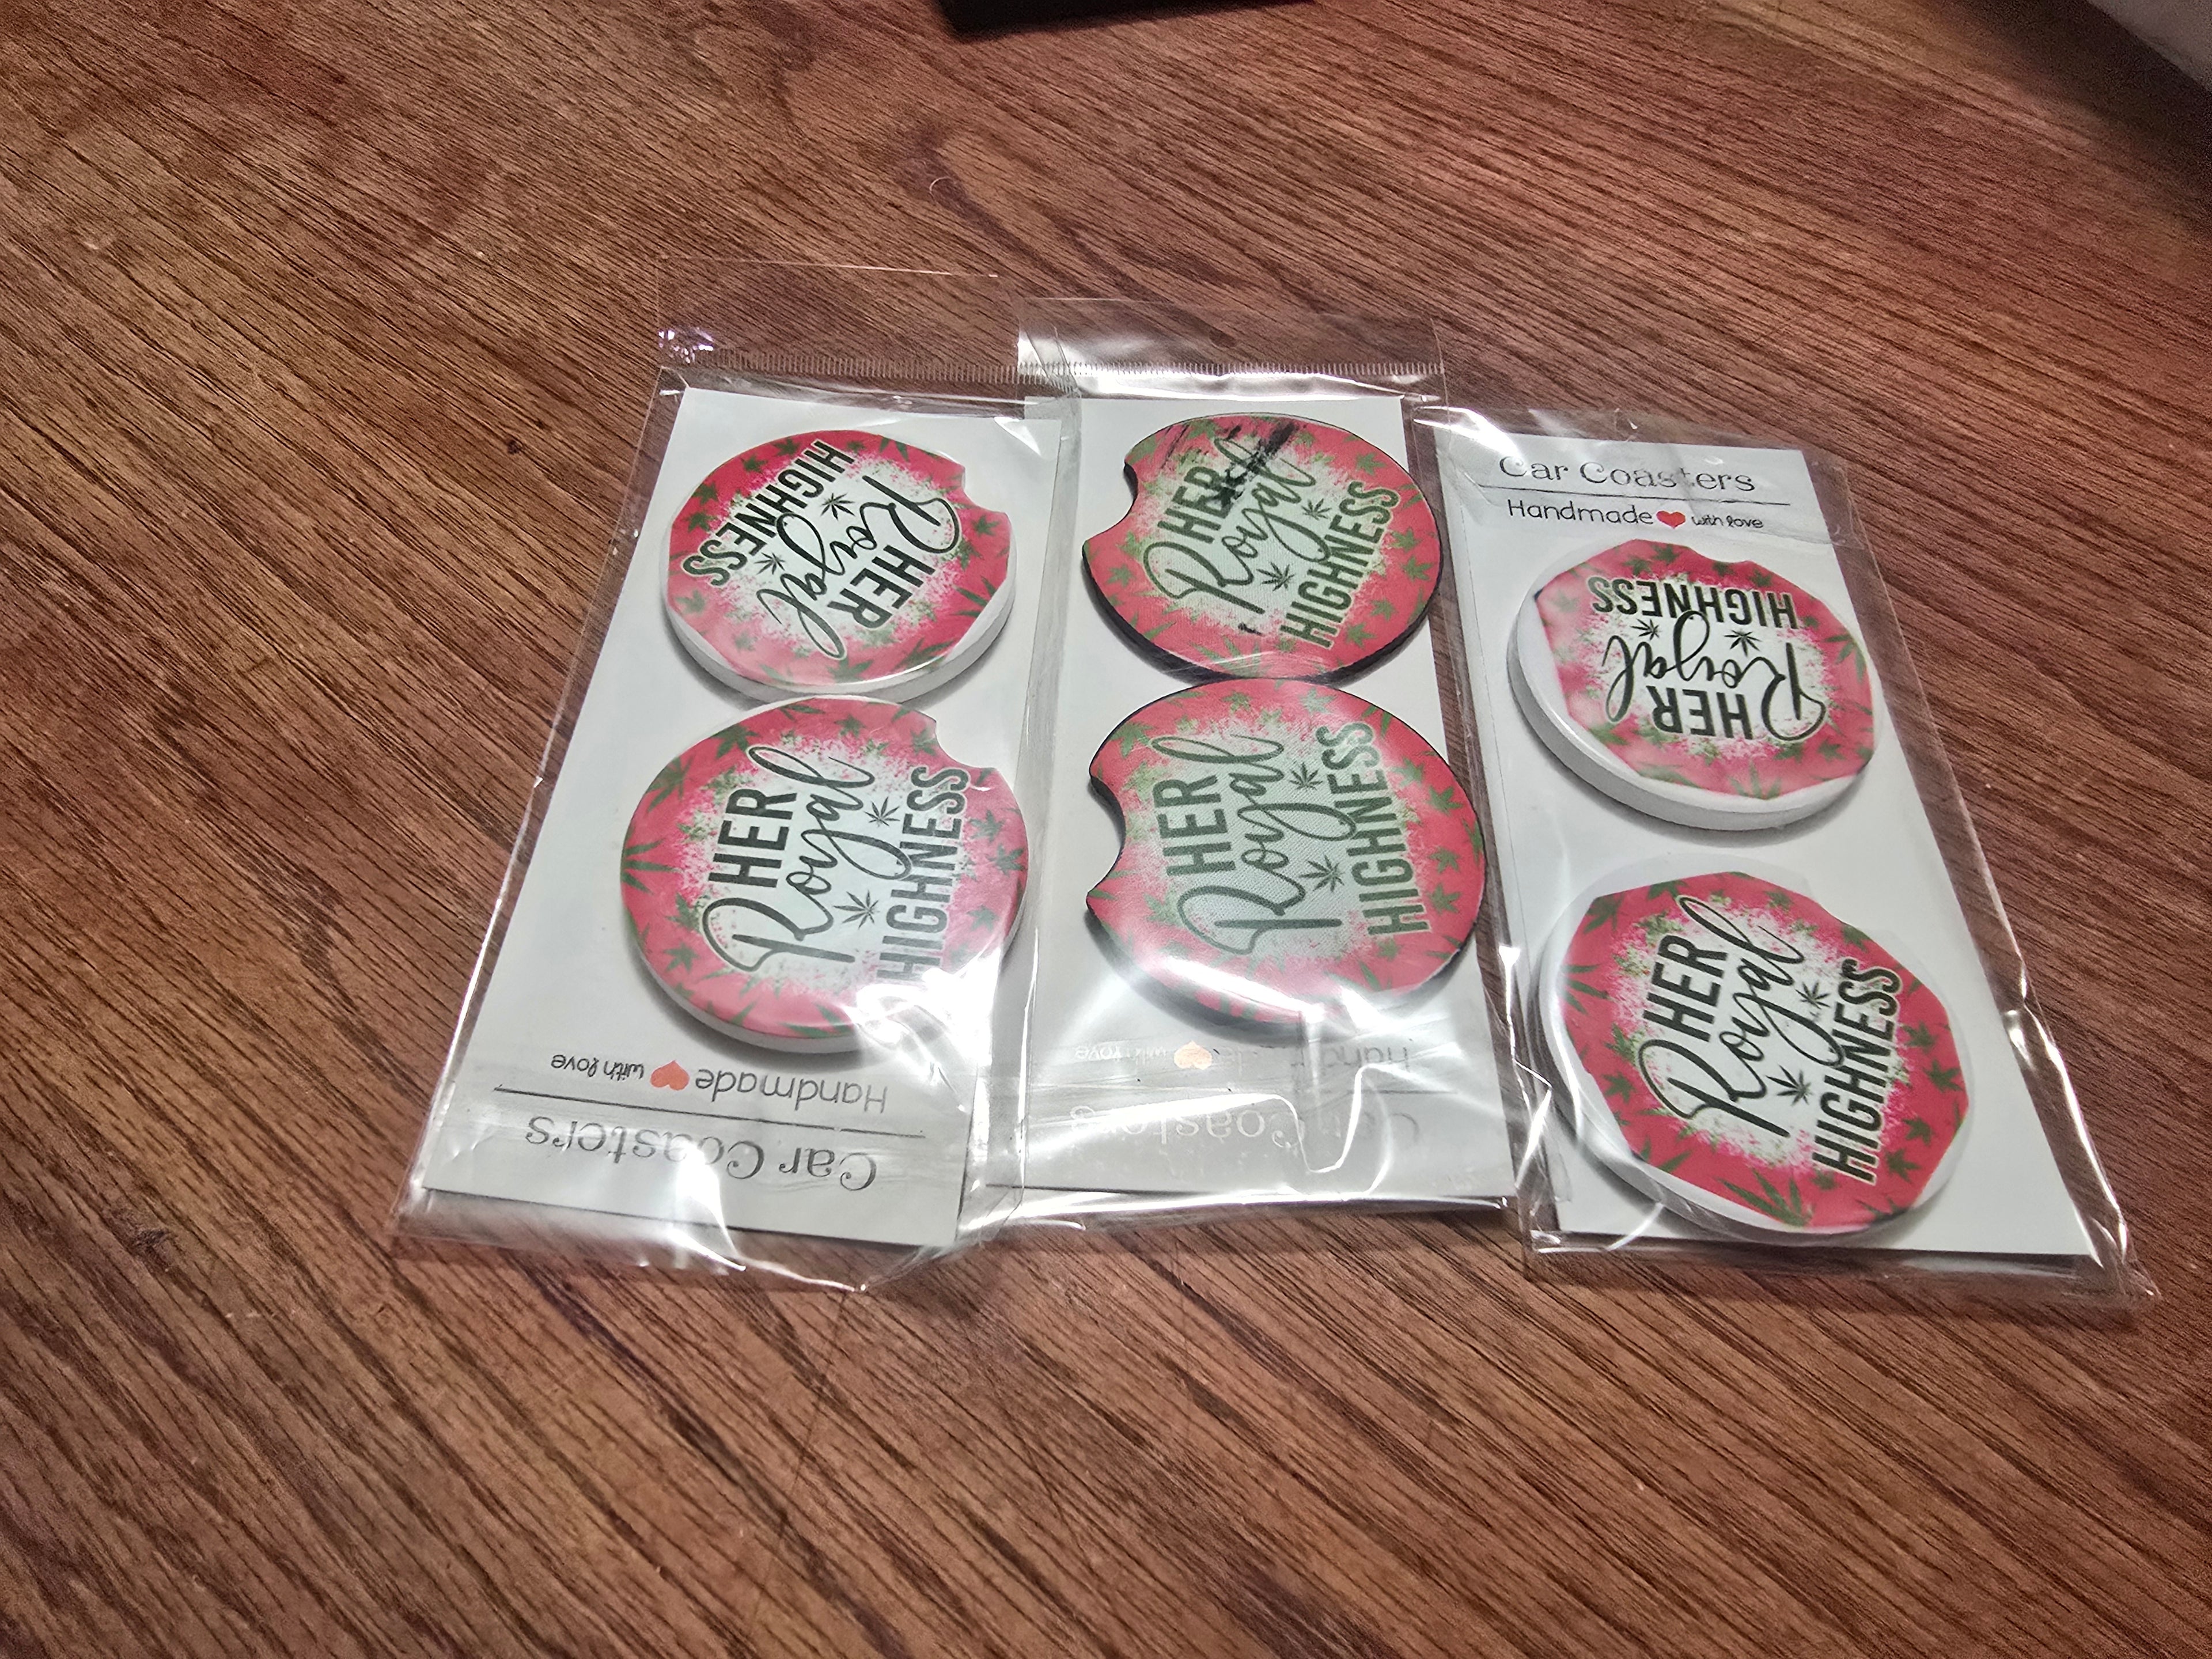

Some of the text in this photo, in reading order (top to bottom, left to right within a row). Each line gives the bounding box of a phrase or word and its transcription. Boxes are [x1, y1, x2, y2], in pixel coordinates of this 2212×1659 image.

[682, 440, 855, 586] HIGHNESS
[1143, 437, 1331, 615] Royal
[1157, 465, 1236, 544] HER
[1499, 456, 1756, 492] Car Coasters
[1507, 499, 1764, 529] Handmade with love
[756, 476, 960, 658] Royal
[828, 543, 937, 629] HER
[1280, 480, 1400, 649] HIGHNESS
[1588, 576, 1799, 629] HIGHNESS
[1601, 610, 1826, 742] Royal
[1645, 684, 1755, 740] HER
[701, 745, 914, 972] Royal
[707, 787, 798, 888] HER
[876, 766, 971, 982] HIGHNESS
[1150, 733, 1358, 955] Royal
[1153, 774, 1237, 877] HER
[1315, 722, 1431, 936] HIGHNESS
[1637, 895, 1845, 1138] Royal
[1642, 934, 1728, 1043] HER
[550, 1054, 889, 1115] Handmade with love
[1811, 957, 1903, 1184] HIGHNESS
[779, 1148, 878, 1192] Car
